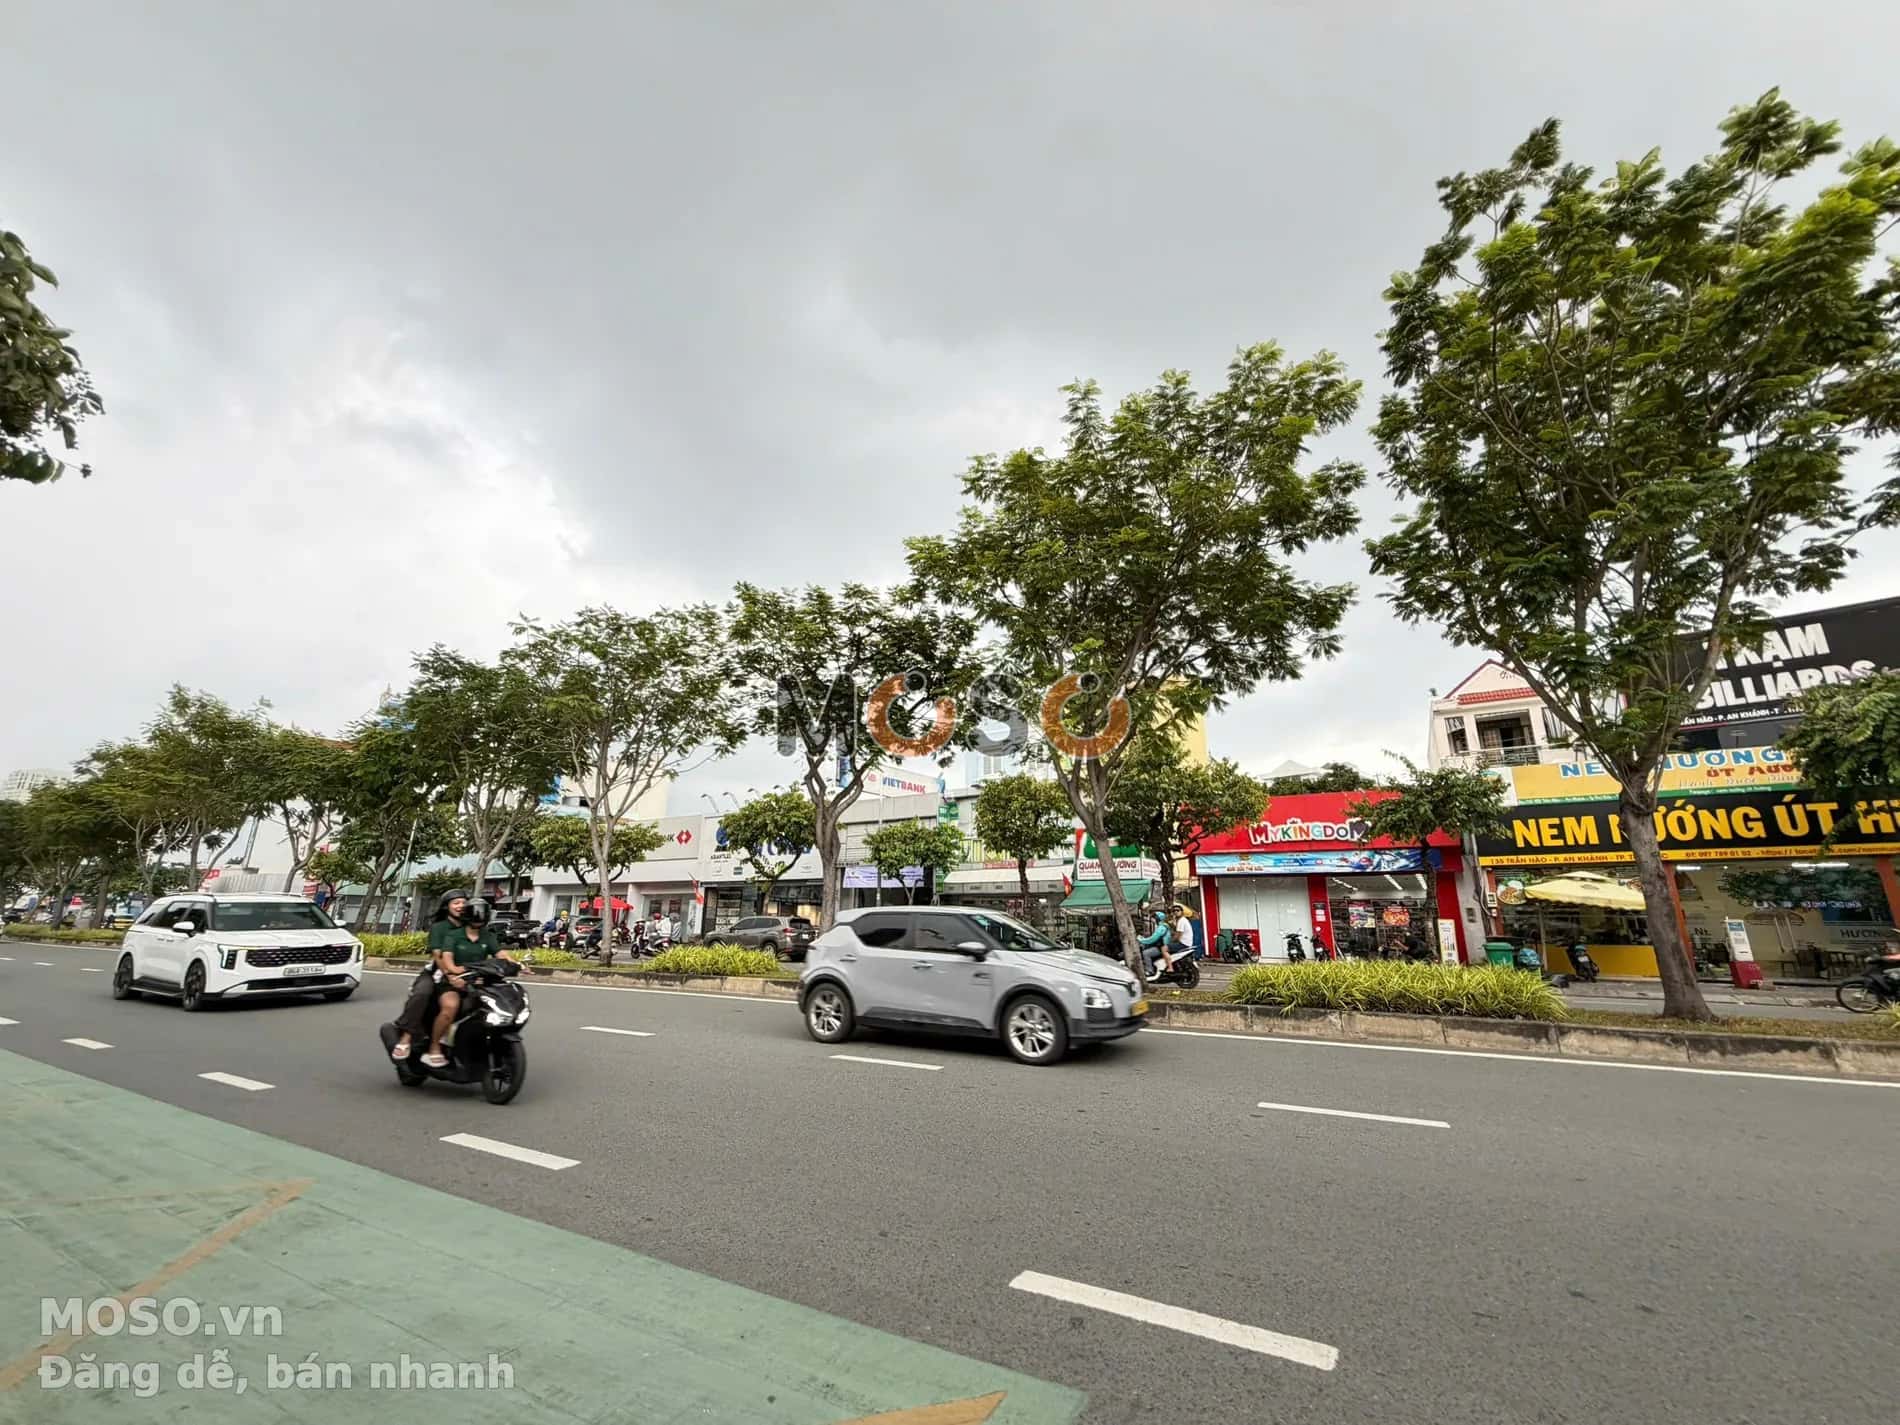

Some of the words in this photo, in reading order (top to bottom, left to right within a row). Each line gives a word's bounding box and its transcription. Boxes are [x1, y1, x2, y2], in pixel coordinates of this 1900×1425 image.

[882, 776, 926, 793] VIETBANK
[1512, 815, 1600, 848] NEM
[1773, 794, 1839, 838] ÚT
[1855, 799, 1900, 834] H
